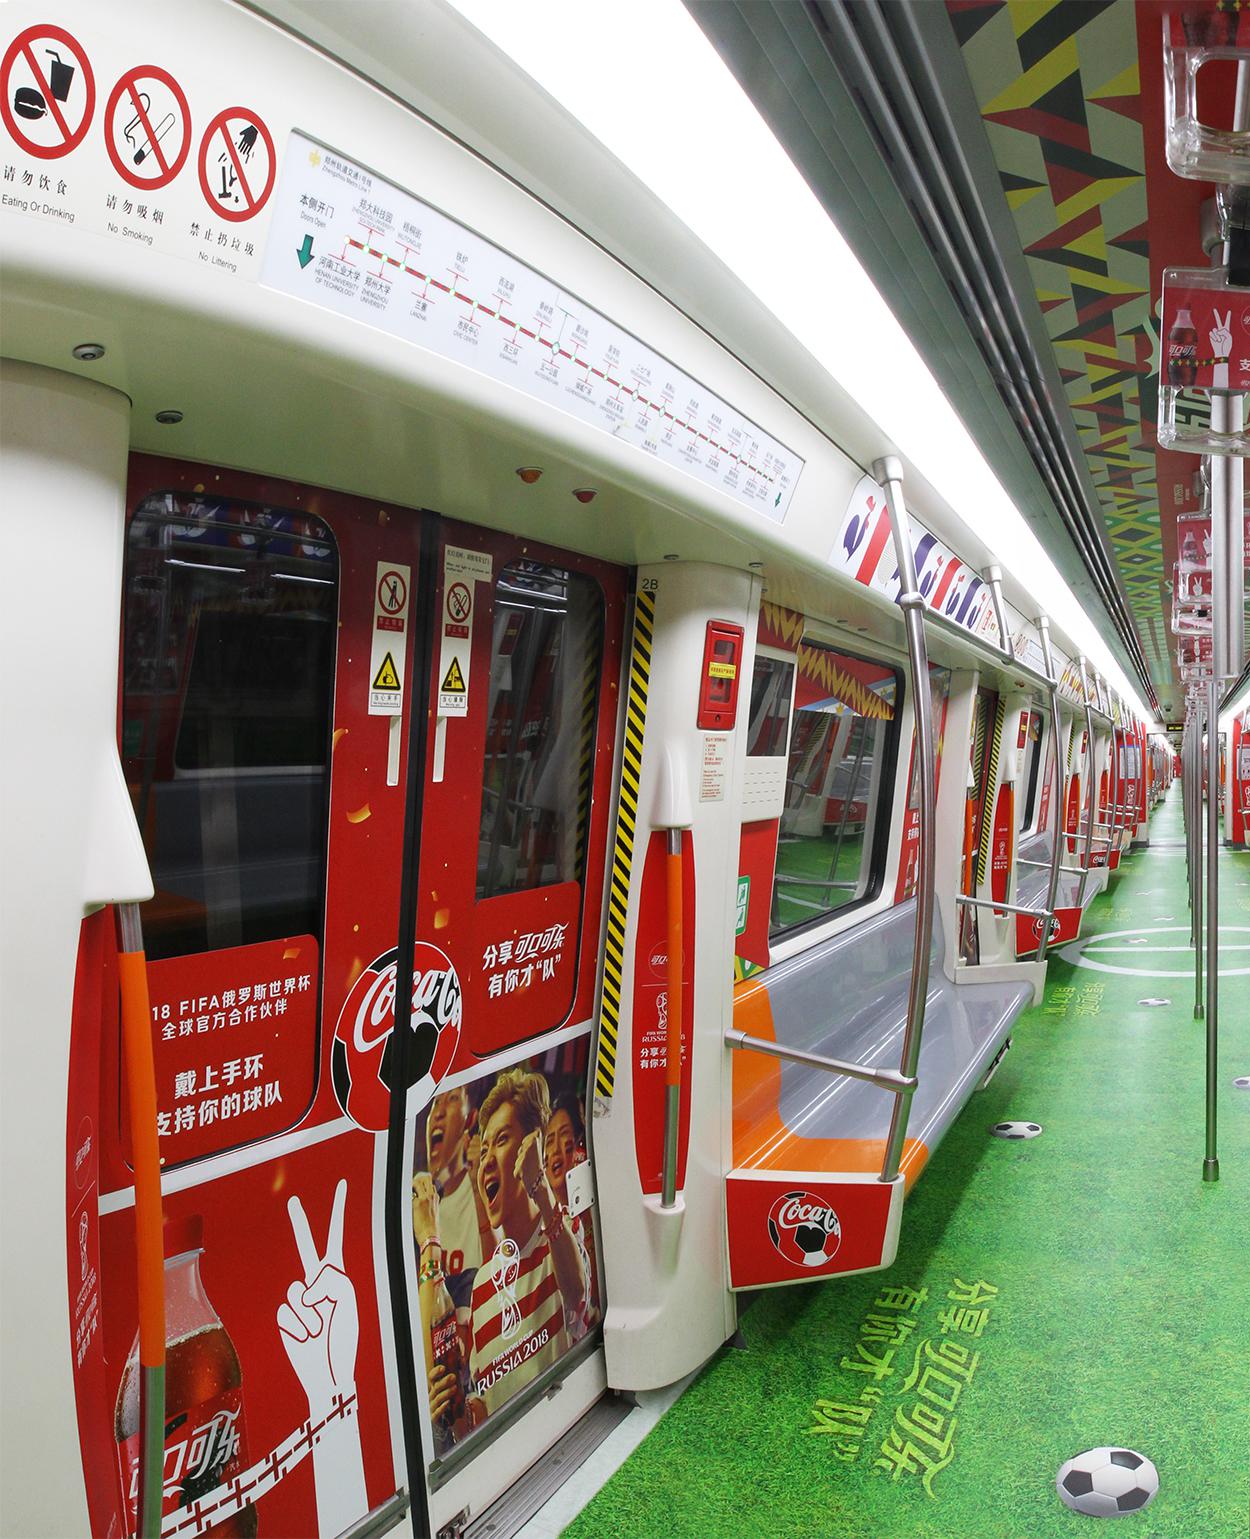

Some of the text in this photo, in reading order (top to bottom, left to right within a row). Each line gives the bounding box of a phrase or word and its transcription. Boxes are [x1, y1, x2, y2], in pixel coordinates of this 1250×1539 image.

[4, 164, 68, 196] 请勿饮食
[2, 194, 75, 223] Eating Or Drinking
[106, 193, 164, 225] 请勿吸烟
[300, 193, 335, 219] 本侧开门
[107, 222, 153, 245] No Smoking
[189, 222, 255, 256] 禁止扔垃圾
[198, 251, 237, 272] No Littering
[642, 578, 658, 590] 2B
[482, 921, 569, 971] 分享可口可乐
[488, 954, 561, 999] 有你才“队”
[152, 974, 311, 1021] 18 FIFA俄罗斯世界杯
[162, 998, 288, 1041] 全球官方合作伙伴
[175, 1054, 264, 1100] 戴上手环
[156, 1081, 283, 1137] 支持你的球队
[477, 1328, 549, 1396] RUSSIA 2018
[874, 1278, 999, 1500] 分享可口可乐
